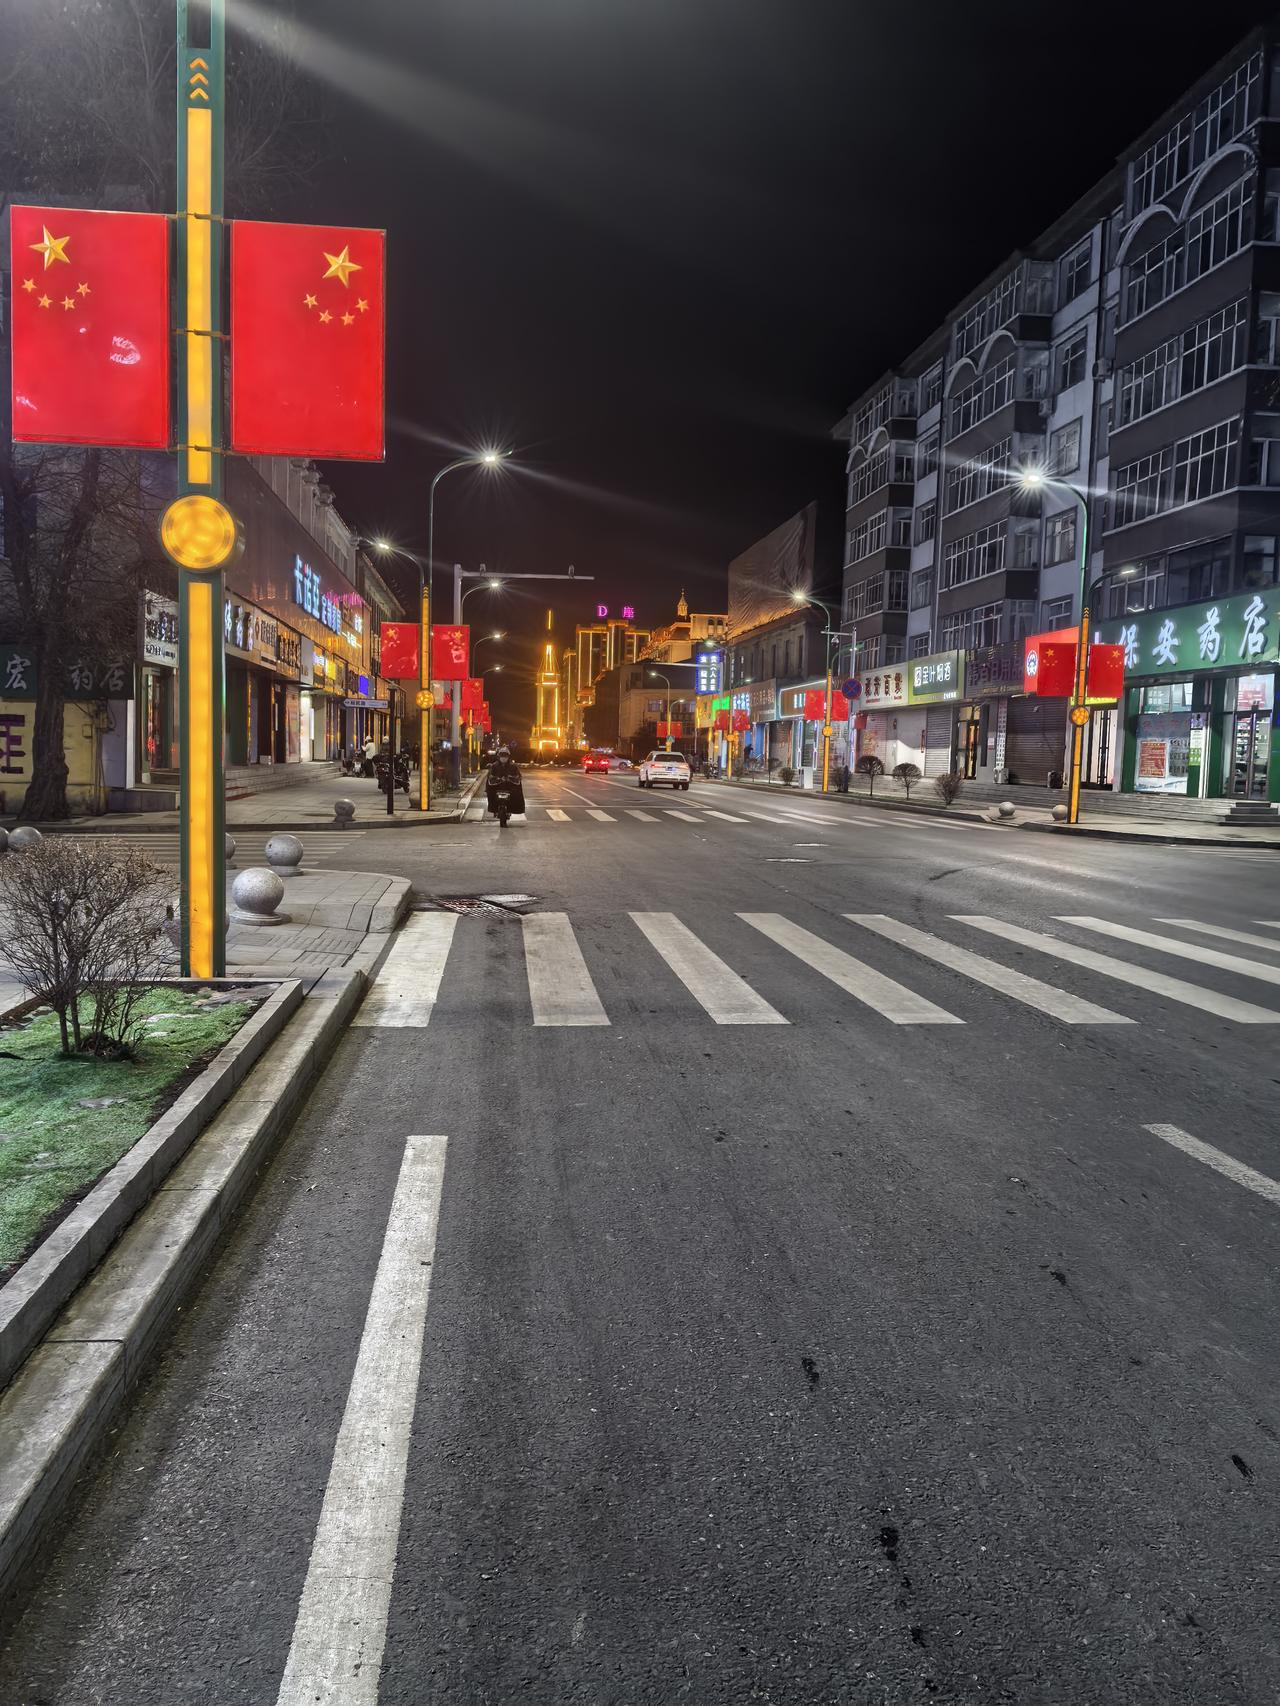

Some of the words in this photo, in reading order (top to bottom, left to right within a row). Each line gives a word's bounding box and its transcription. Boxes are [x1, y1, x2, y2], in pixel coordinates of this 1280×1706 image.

[598, 606, 607, 617] D
[1088, 596, 1266, 669] 保安药店
[5, 654, 126, 691] 宏药店
